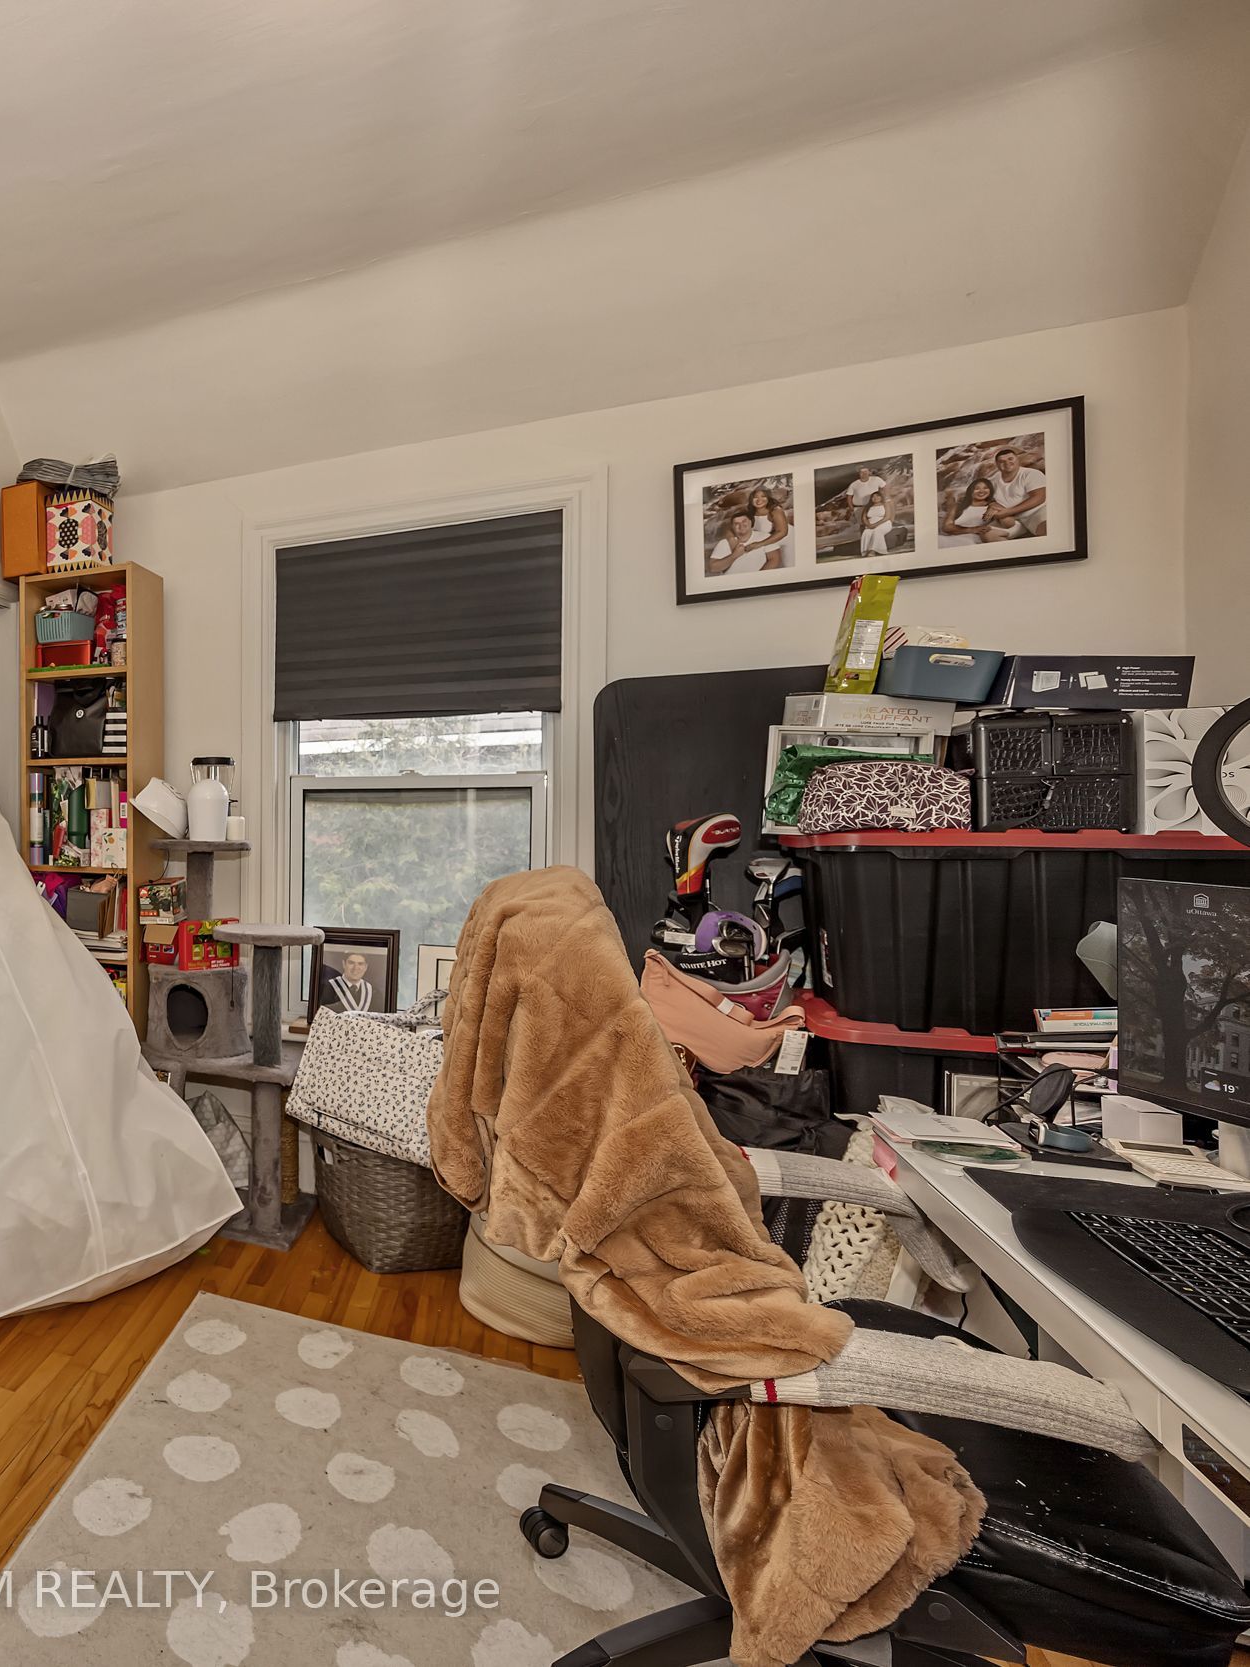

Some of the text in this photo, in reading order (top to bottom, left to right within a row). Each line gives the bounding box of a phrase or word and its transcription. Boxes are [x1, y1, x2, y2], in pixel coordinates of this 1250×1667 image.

[859, 707, 919, 716] HEATED
[842, 712, 933, 723] CHAUFFANT
[1186, 908, 1217, 917] uOttawa
[707, 958, 727, 967] HOT
